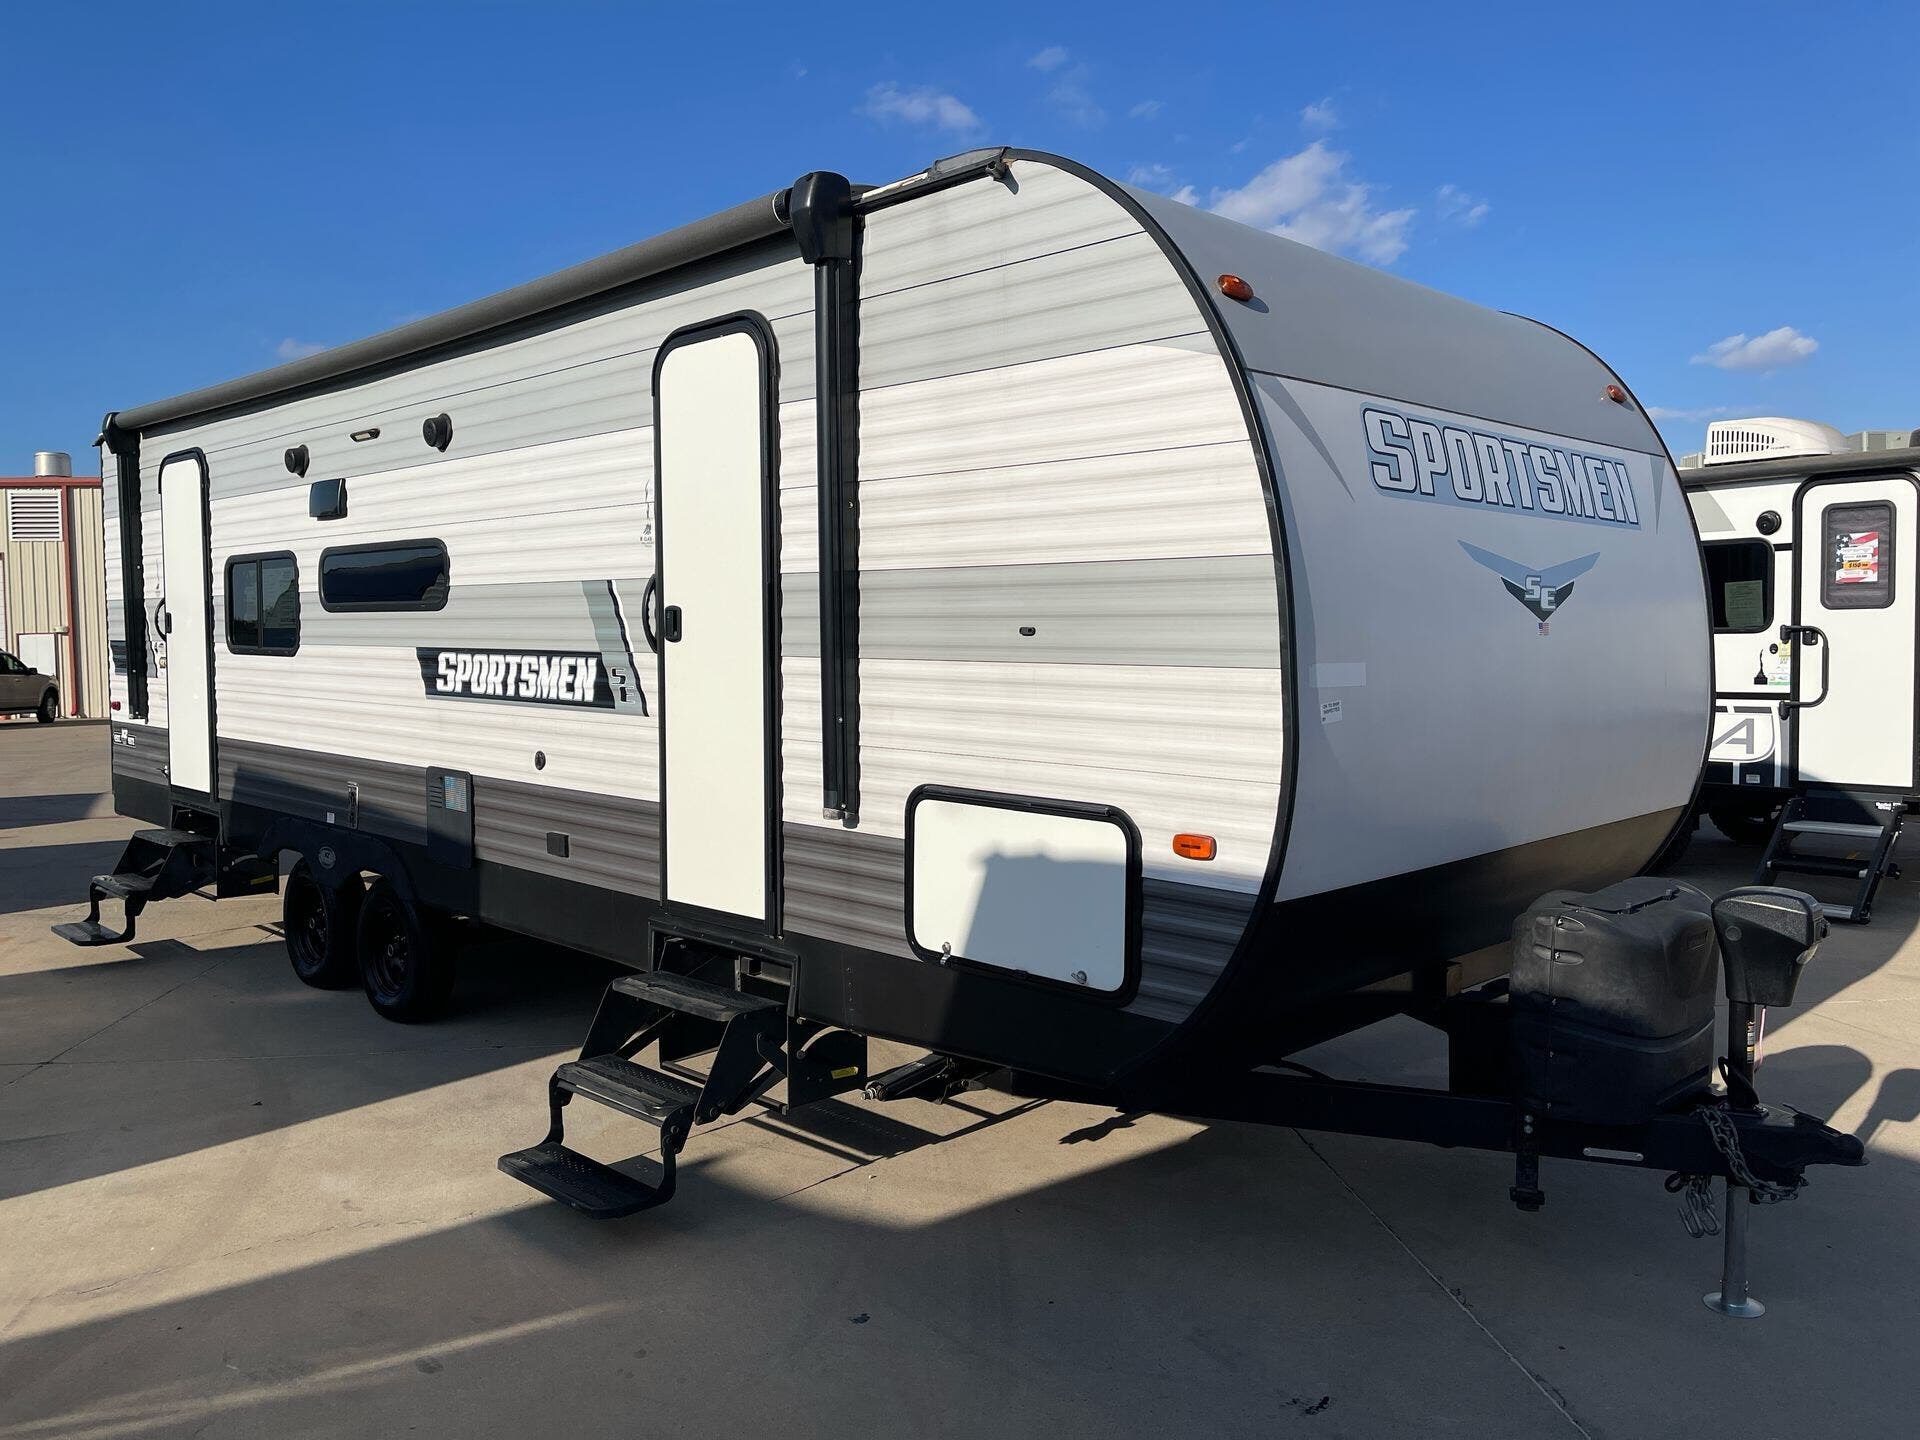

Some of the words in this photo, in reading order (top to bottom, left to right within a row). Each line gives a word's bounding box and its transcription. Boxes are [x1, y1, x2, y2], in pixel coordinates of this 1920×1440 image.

[1363, 407, 1640, 526] SPORTSMEN
[1524, 575, 1557, 611] SE
[435, 651, 598, 703] SPORTSMEN
